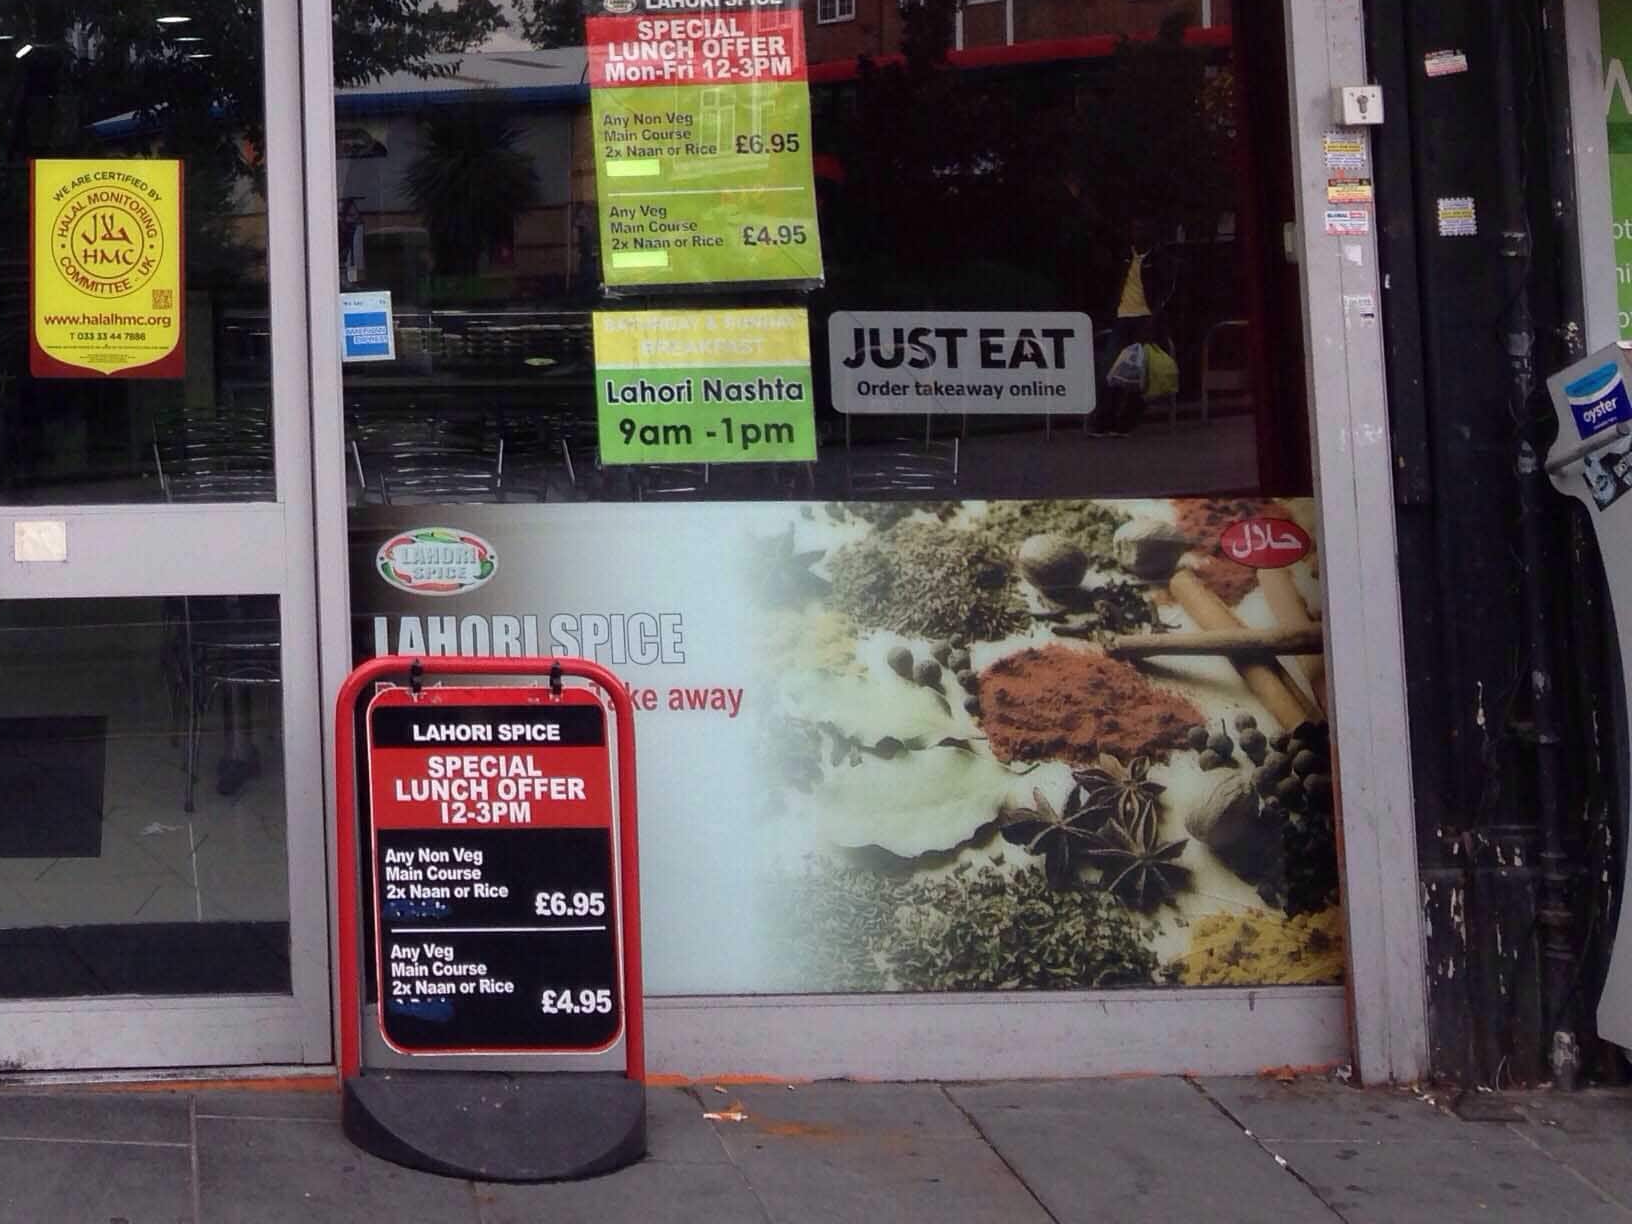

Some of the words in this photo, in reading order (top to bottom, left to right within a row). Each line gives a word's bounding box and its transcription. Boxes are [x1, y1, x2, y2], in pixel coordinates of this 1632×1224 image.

[638, 18, 745, 40] SPECIAL
[609, 41, 694, 62] LUNCH
[702, 36, 785, 58] OFFER
[604, 60, 694, 82] Mon-Fri
[702, 57, 792, 78] 12-3PM
[603, 114, 629, 128] Any
[634, 113, 661, 125] Non
[666, 112, 693, 126] Veg
[604, 130, 637, 141] Main
[642, 128, 692, 140] Course
[735, 133, 800, 154] £6.95
[605, 146, 622, 157] 2x
[626, 145, 663, 156] Naan
[667, 147, 681, 155] or
[685, 143, 717, 155] Rice
[53, 185, 70, 202] WE
[71, 174, 92, 189] ARE
[94, 171, 150, 192] CERTIFIED
[147, 188, 163, 203] BY
[57, 200, 87, 238] HALAL
[87, 191, 158, 239] MONITORING
[609, 206, 636, 220] Any
[640, 205, 667, 219] Veg
[648, 220, 698, 232] Course
[743, 225, 807, 246] £4.95
[612, 238, 629, 250] 2x
[633, 237, 670, 248] Naan
[675, 239, 688, 247] or
[692, 235, 724, 247] Rice
[83, 248, 135, 266] HMC
[60, 256, 132, 294] COMMITTEE
[138, 256, 157, 276] UK
[44, 313, 171, 328] www.halalhmc.org
[842, 327, 968, 369] JUST
[979, 328, 1075, 369] EAT
[605, 378, 693, 404] Lahori
[701, 377, 804, 402] Nashta
[857, 381, 910, 397] Order
[914, 381, 1004, 400] takeaway
[1009, 381, 1066, 397] online
[1583, 397, 1617, 423] oyster
[619, 418, 692, 446] 9am
[400, 543, 477, 565] LAHORI
[414, 567, 468, 580] SPICE
[374, 614, 539, 657] LAHORI
[549, 612, 686, 665] SPICE
[668, 686, 744, 718] away
[413, 725, 492, 742] LAHORI
[499, 724, 561, 741] SPICE
[428, 755, 542, 778] SPECIAL
[396, 779, 488, 802] LUNCH
[498, 778, 586, 800] OFFER
[440, 801, 531, 824] 12-3PM
[385, 848, 414, 866] Any
[418, 848, 449, 863] Non
[453, 847, 483, 865] Veg
[386, 866, 423, 881] Main
[427, 866, 482, 881] Course
[387, 885, 406, 899] 2x
[410, 884, 451, 899] Naan
[455, 887, 470, 898] or
[474, 883, 508, 898] Rice
[535, 892, 605, 916] £6.95
[391, 945, 420, 962] Any
[424, 944, 454, 961] Veg
[392, 963, 429, 977] Main
[432, 962, 487, 976] Course
[393, 981, 412, 995] 2x
[416, 980, 456, 995] Naan
[460, 983, 476, 994] or
[479, 979, 514, 994] Rice
[542, 990, 612, 1014] £4.95
